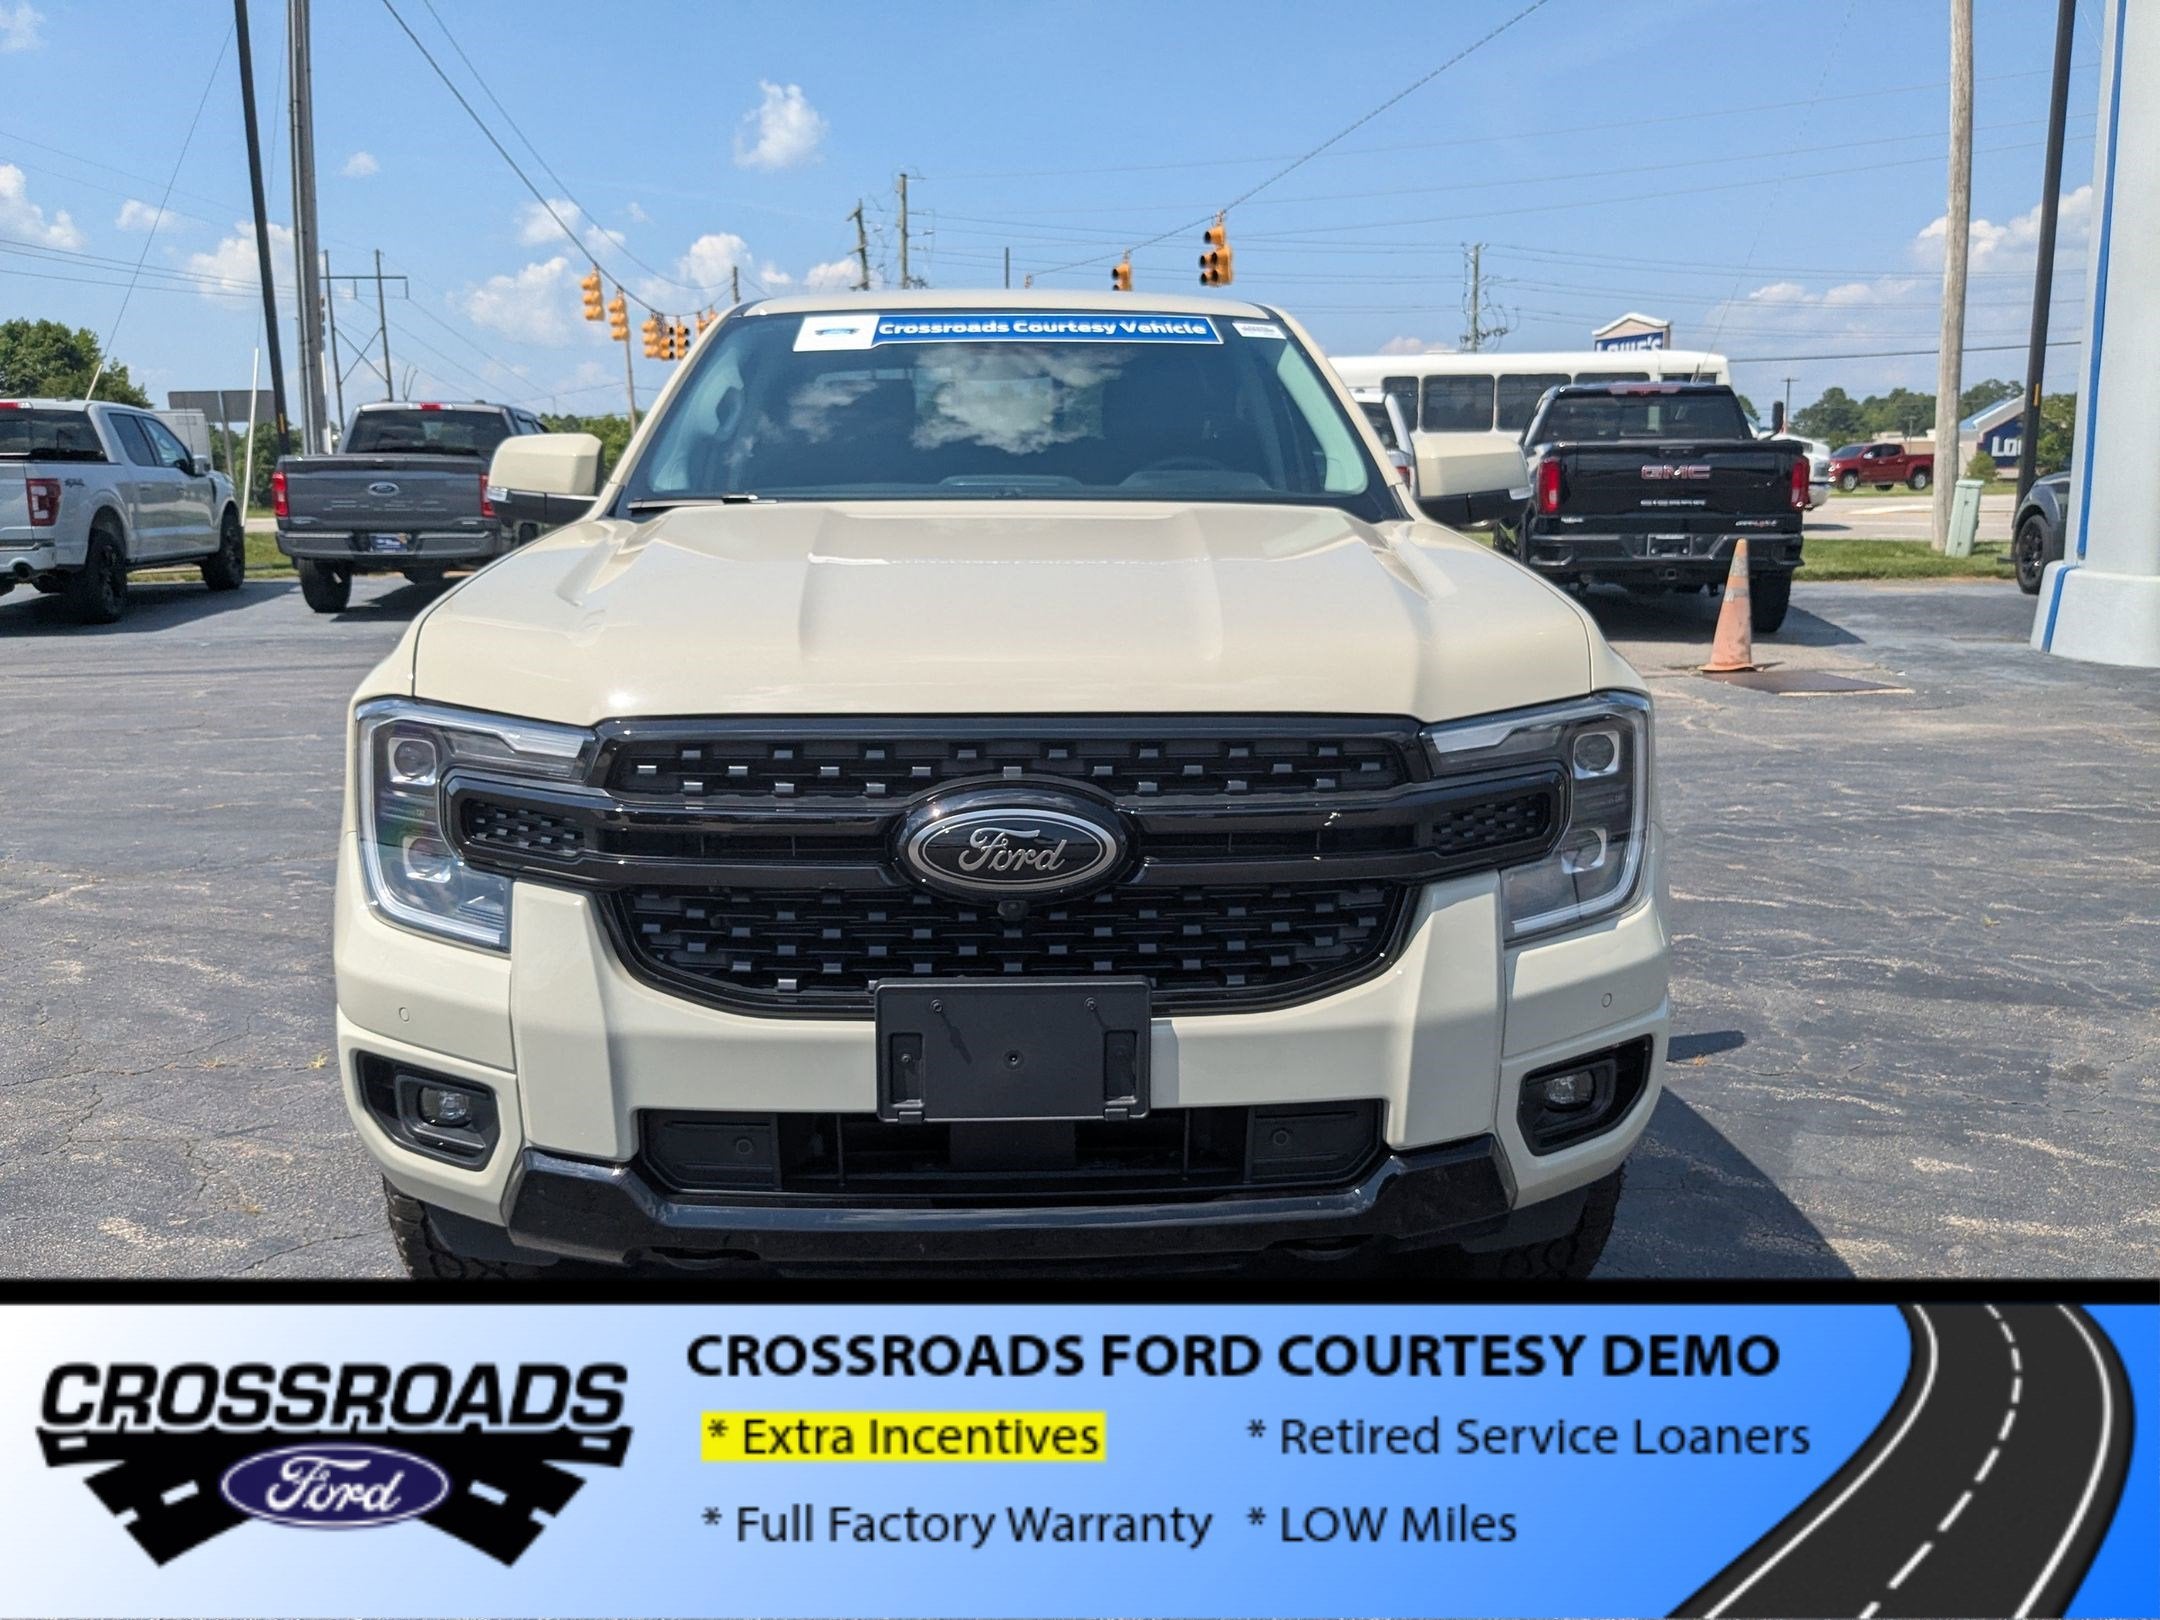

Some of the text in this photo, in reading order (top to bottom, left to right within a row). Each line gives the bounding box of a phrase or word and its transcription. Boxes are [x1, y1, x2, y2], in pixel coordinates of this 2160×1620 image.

[878, 320, 1208, 335] Crossroads Courtesy Vehicle
[1991, 436, 2021, 457] LO
[1641, 465, 1711, 480] GMC
[958, 827, 1067, 872] Ford
